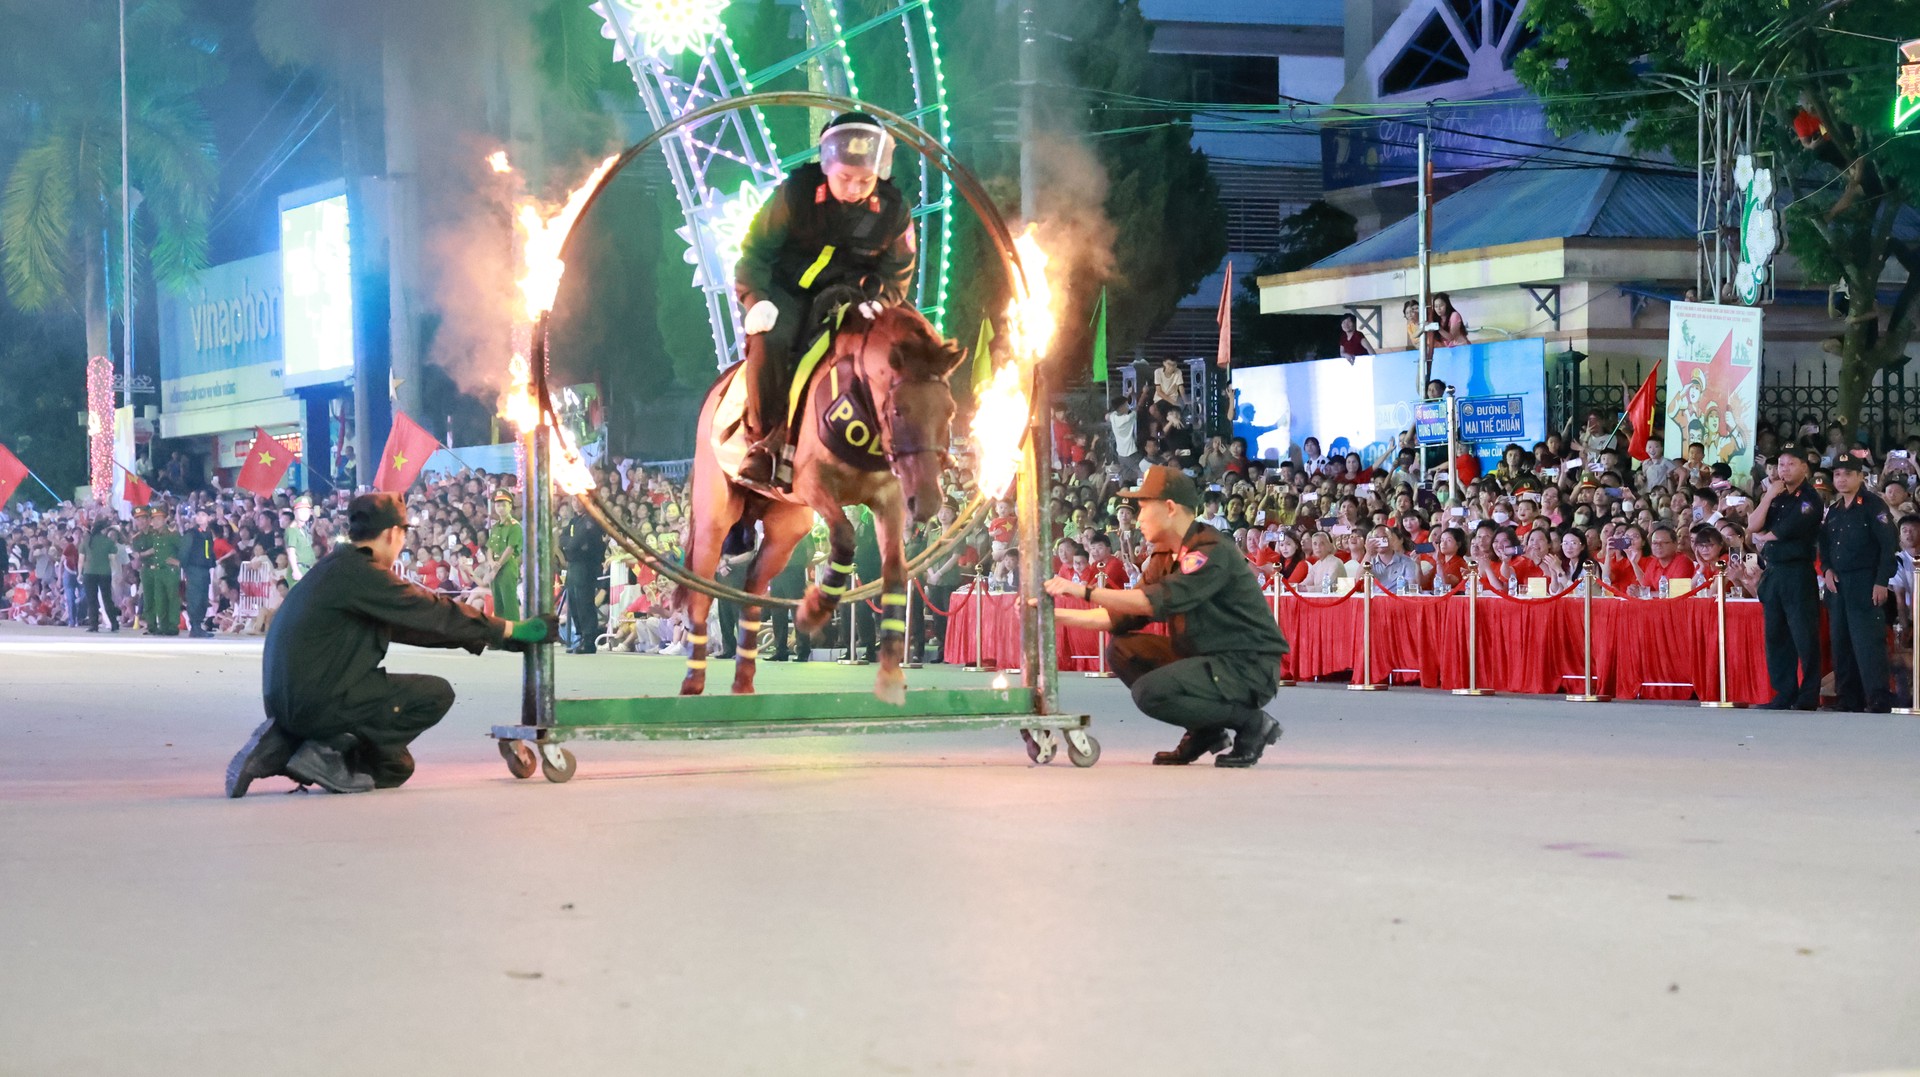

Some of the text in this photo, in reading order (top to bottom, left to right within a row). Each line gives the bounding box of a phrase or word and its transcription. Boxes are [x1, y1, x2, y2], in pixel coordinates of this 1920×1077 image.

[1476, 404, 1507, 416] ĐƯỜNG
[1465, 413, 1520, 434] MAI THẾ CHUẨN
